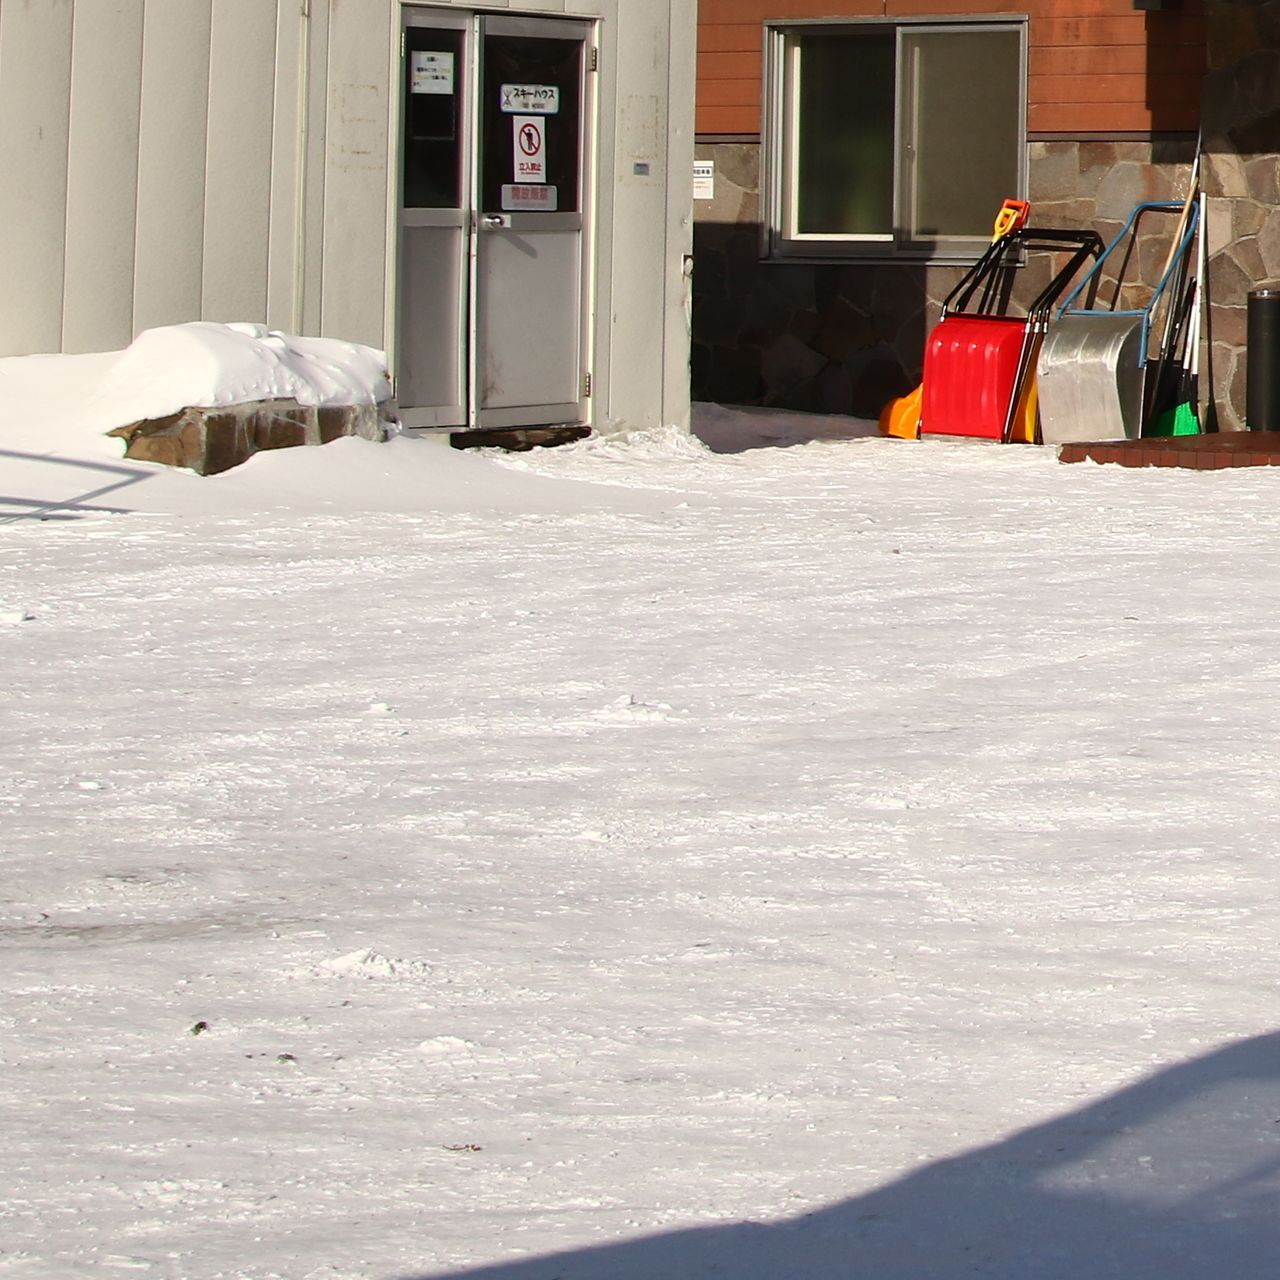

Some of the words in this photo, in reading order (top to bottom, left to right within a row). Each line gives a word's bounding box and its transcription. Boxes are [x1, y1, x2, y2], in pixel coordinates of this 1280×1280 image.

[513, 87, 555, 99] スキーハウス
